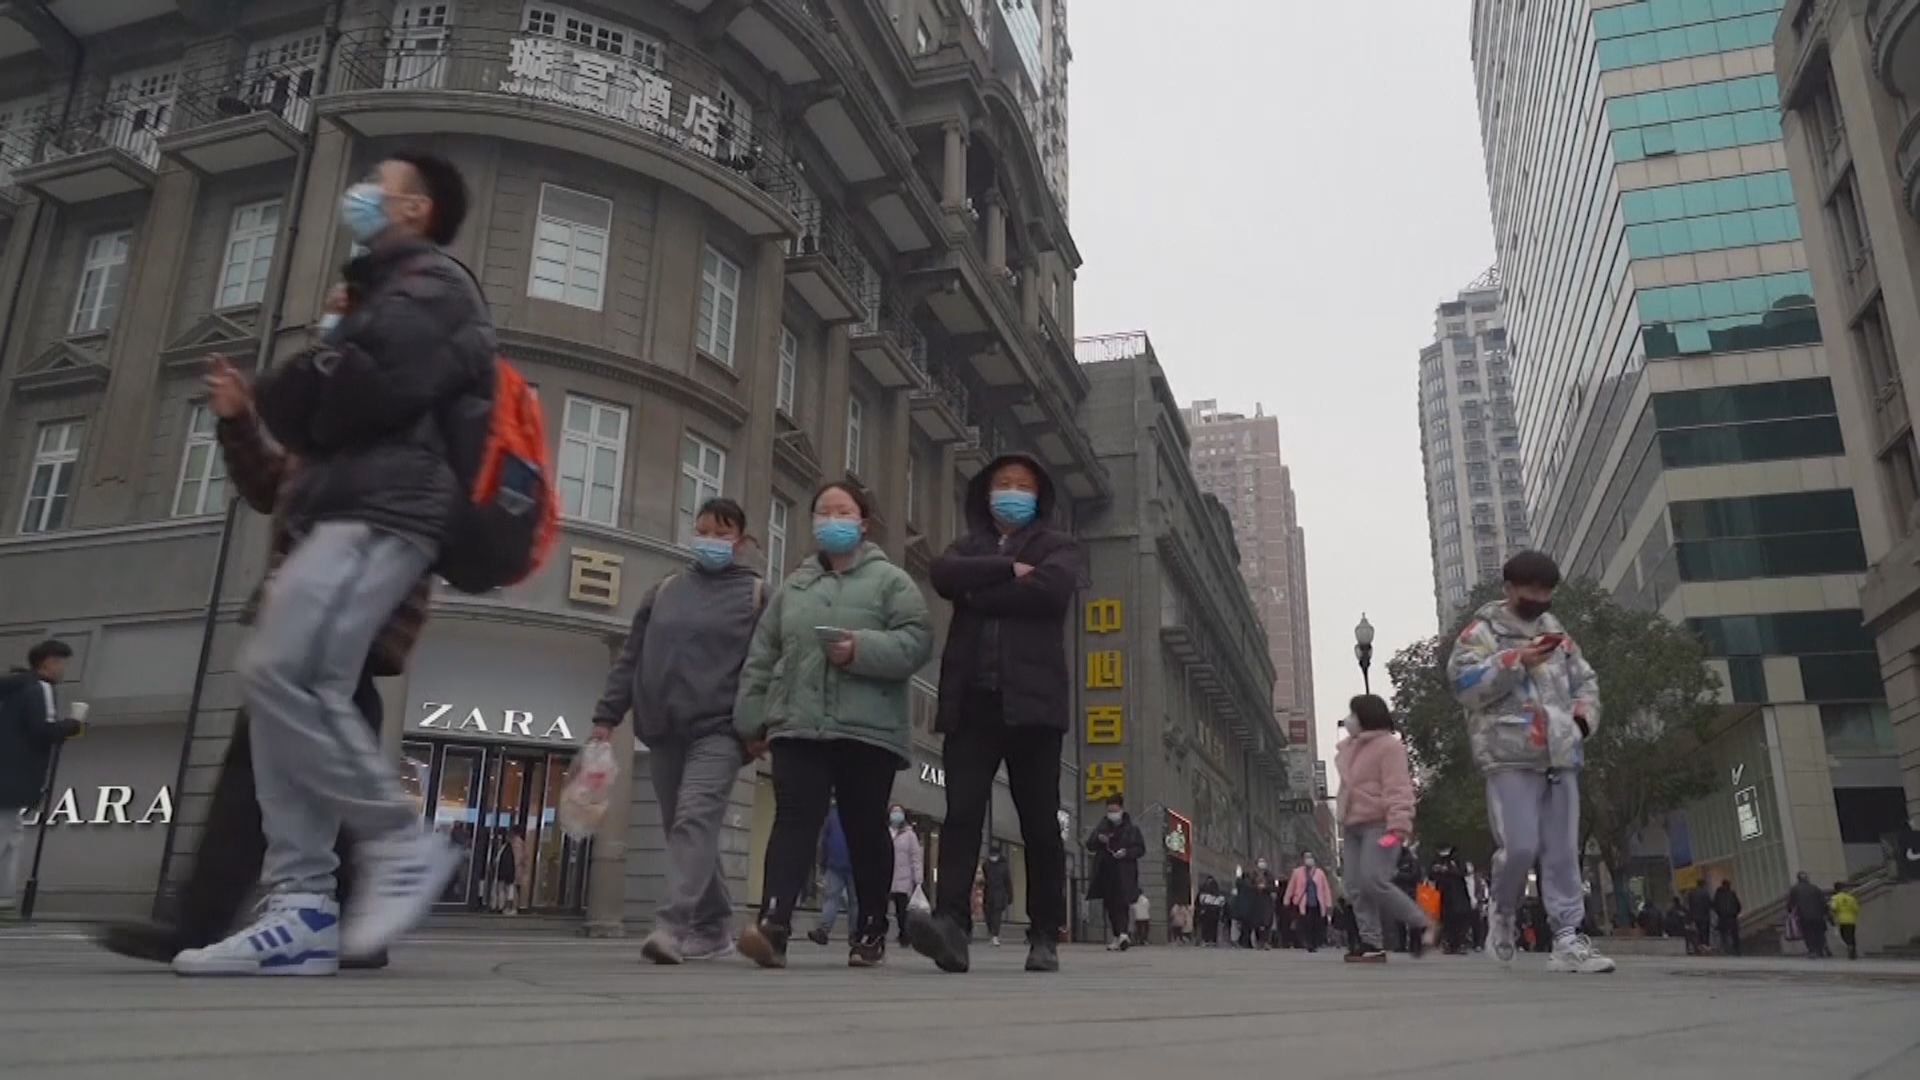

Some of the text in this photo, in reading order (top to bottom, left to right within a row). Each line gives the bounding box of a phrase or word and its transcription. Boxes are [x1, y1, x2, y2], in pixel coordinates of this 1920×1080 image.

[568, 546, 625, 607] 百
[418, 701, 575, 740] ZARA
[1085, 598, 1125, 802] 中心百货
